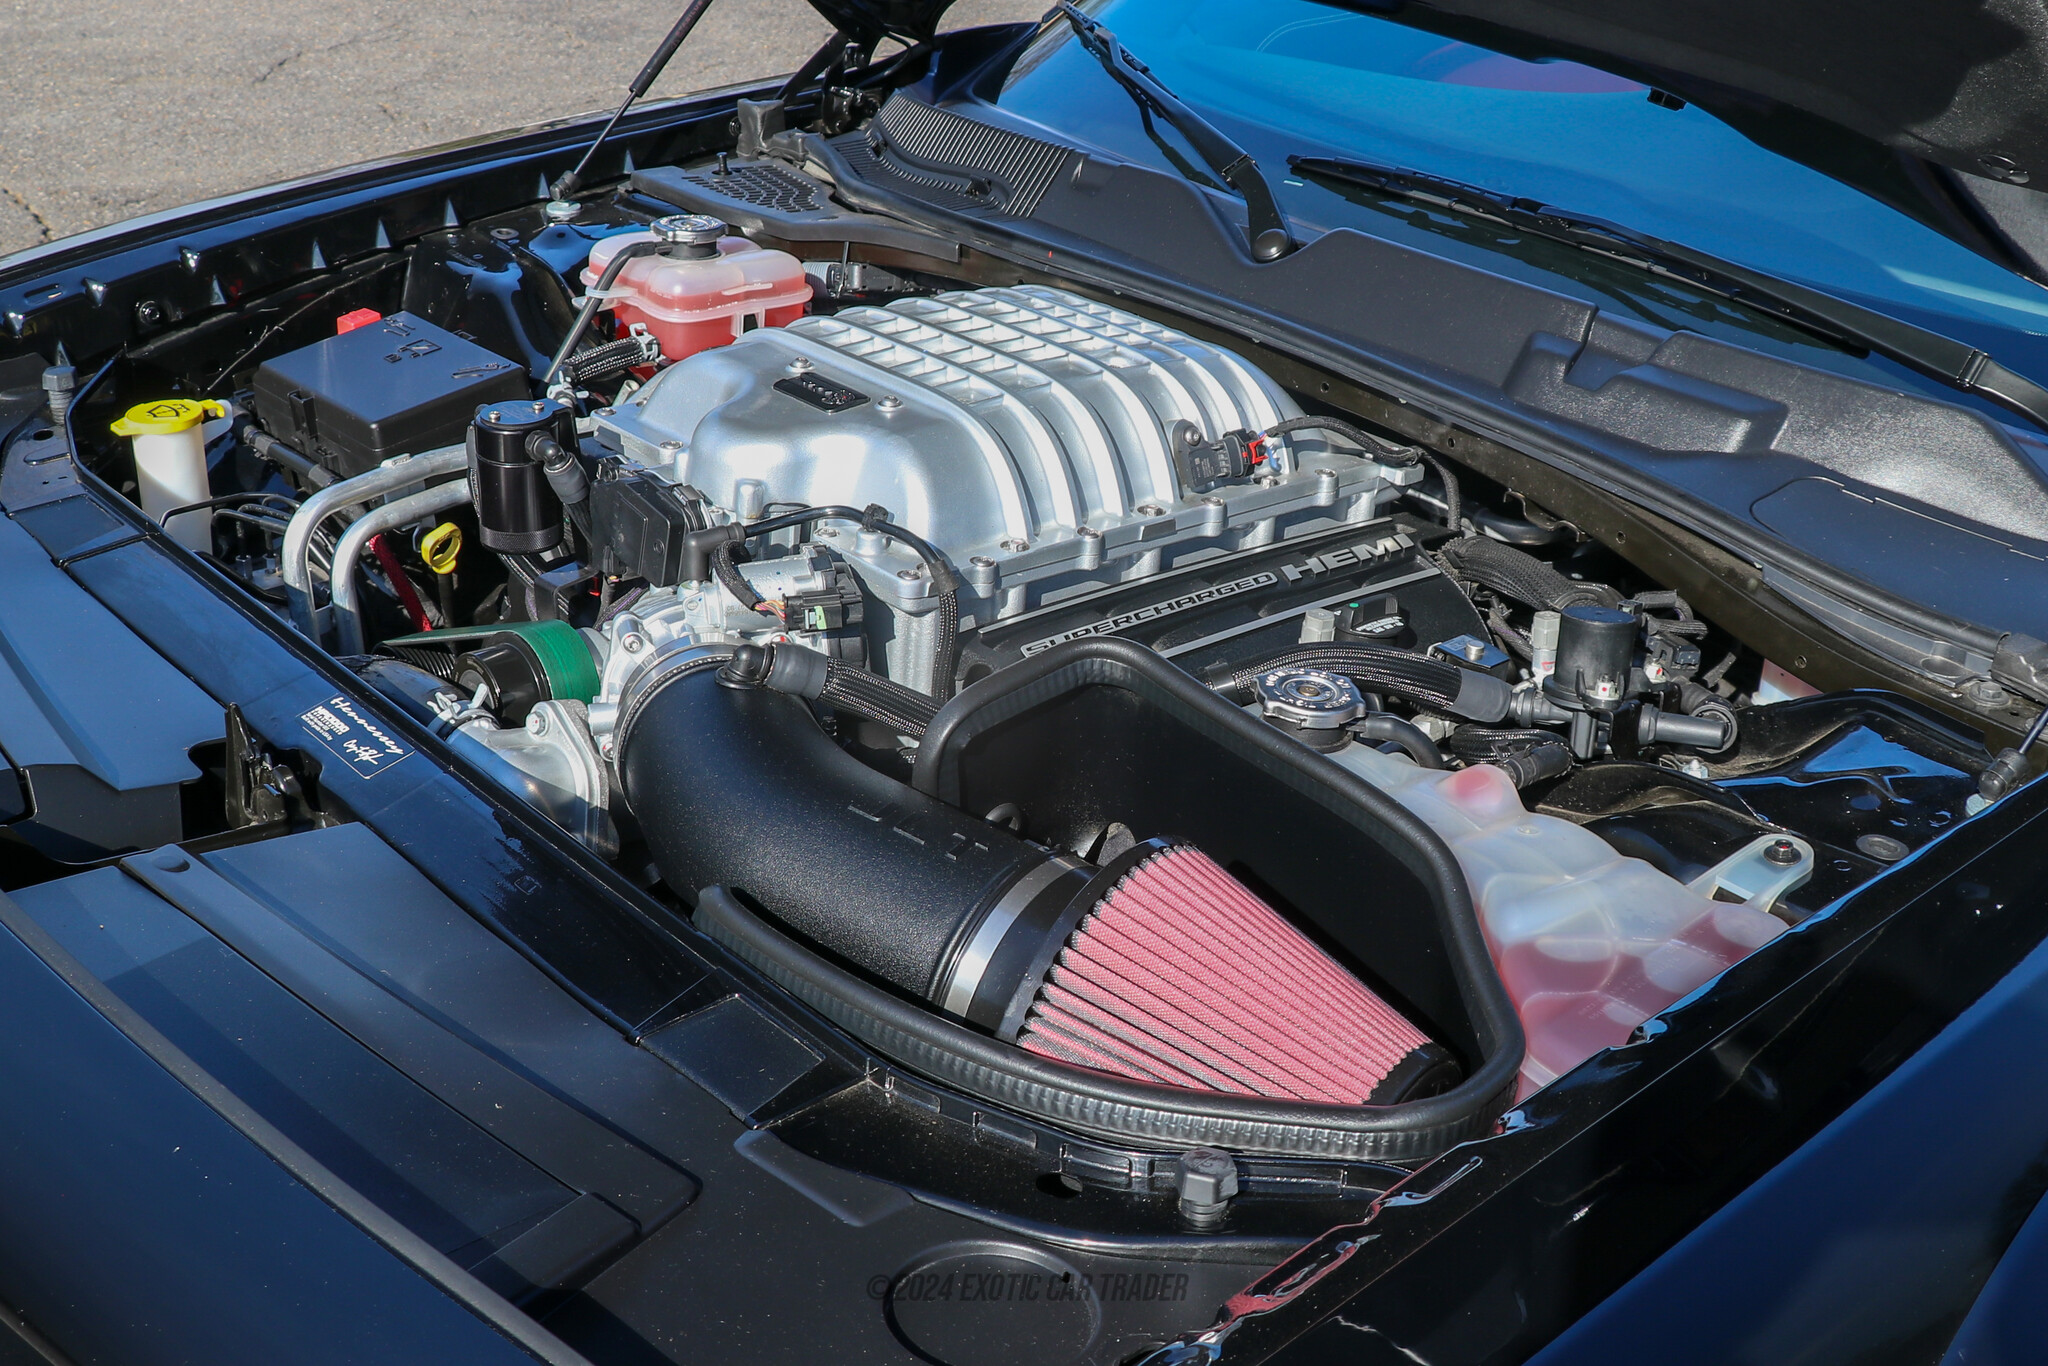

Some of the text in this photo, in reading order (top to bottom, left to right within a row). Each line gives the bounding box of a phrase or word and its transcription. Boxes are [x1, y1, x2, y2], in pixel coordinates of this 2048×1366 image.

[1024, 533, 1415, 656] SUPERCHARGED HEMI
[330, 696, 404, 755] Hennessey
